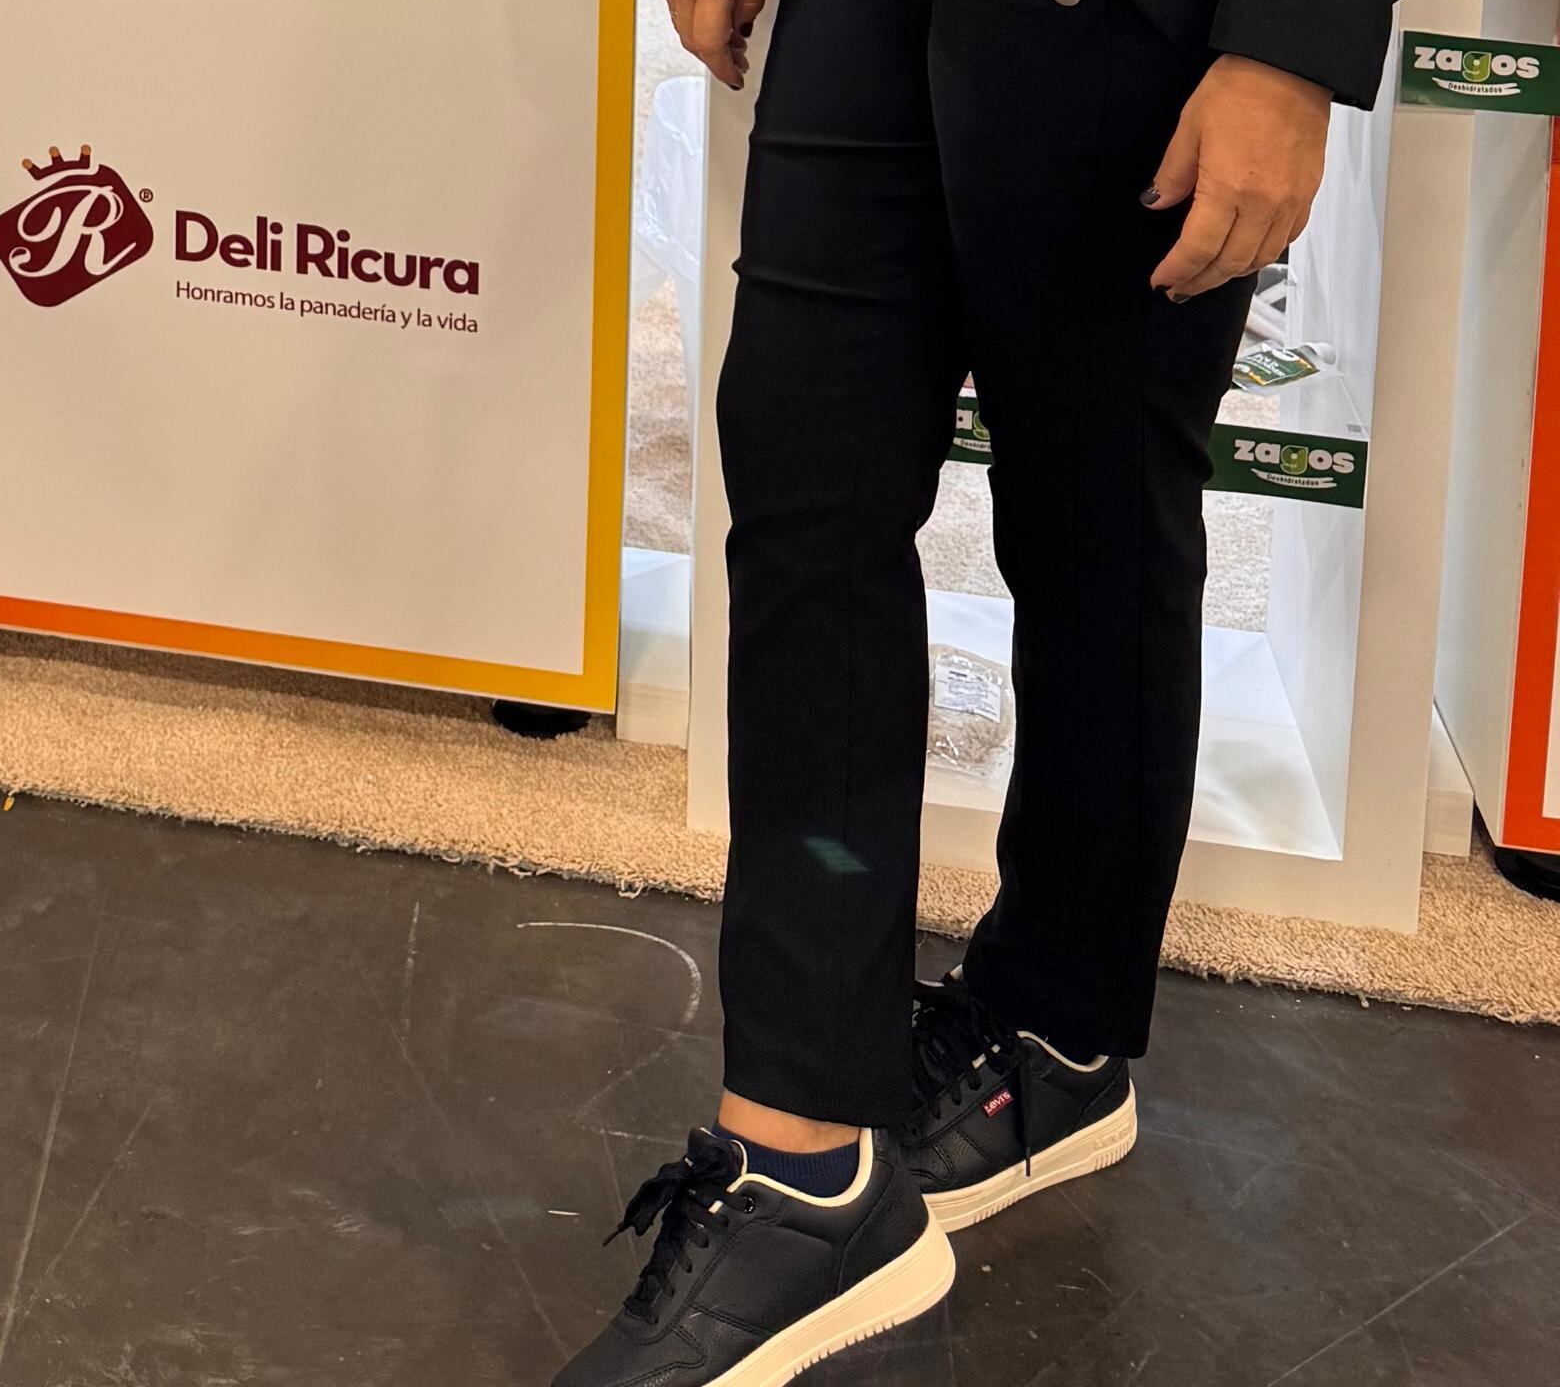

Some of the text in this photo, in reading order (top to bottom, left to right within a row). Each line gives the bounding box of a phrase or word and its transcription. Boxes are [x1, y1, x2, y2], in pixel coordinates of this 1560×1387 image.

[1413, 45, 1540, 83] zagos
[1447, 82, 1503, 94] Deshidratados
[174, 208, 480, 296] Deli Ricura
[174, 279, 479, 334] Honramos la panadería y la vida
[1233, 438, 1356, 475] zagos
